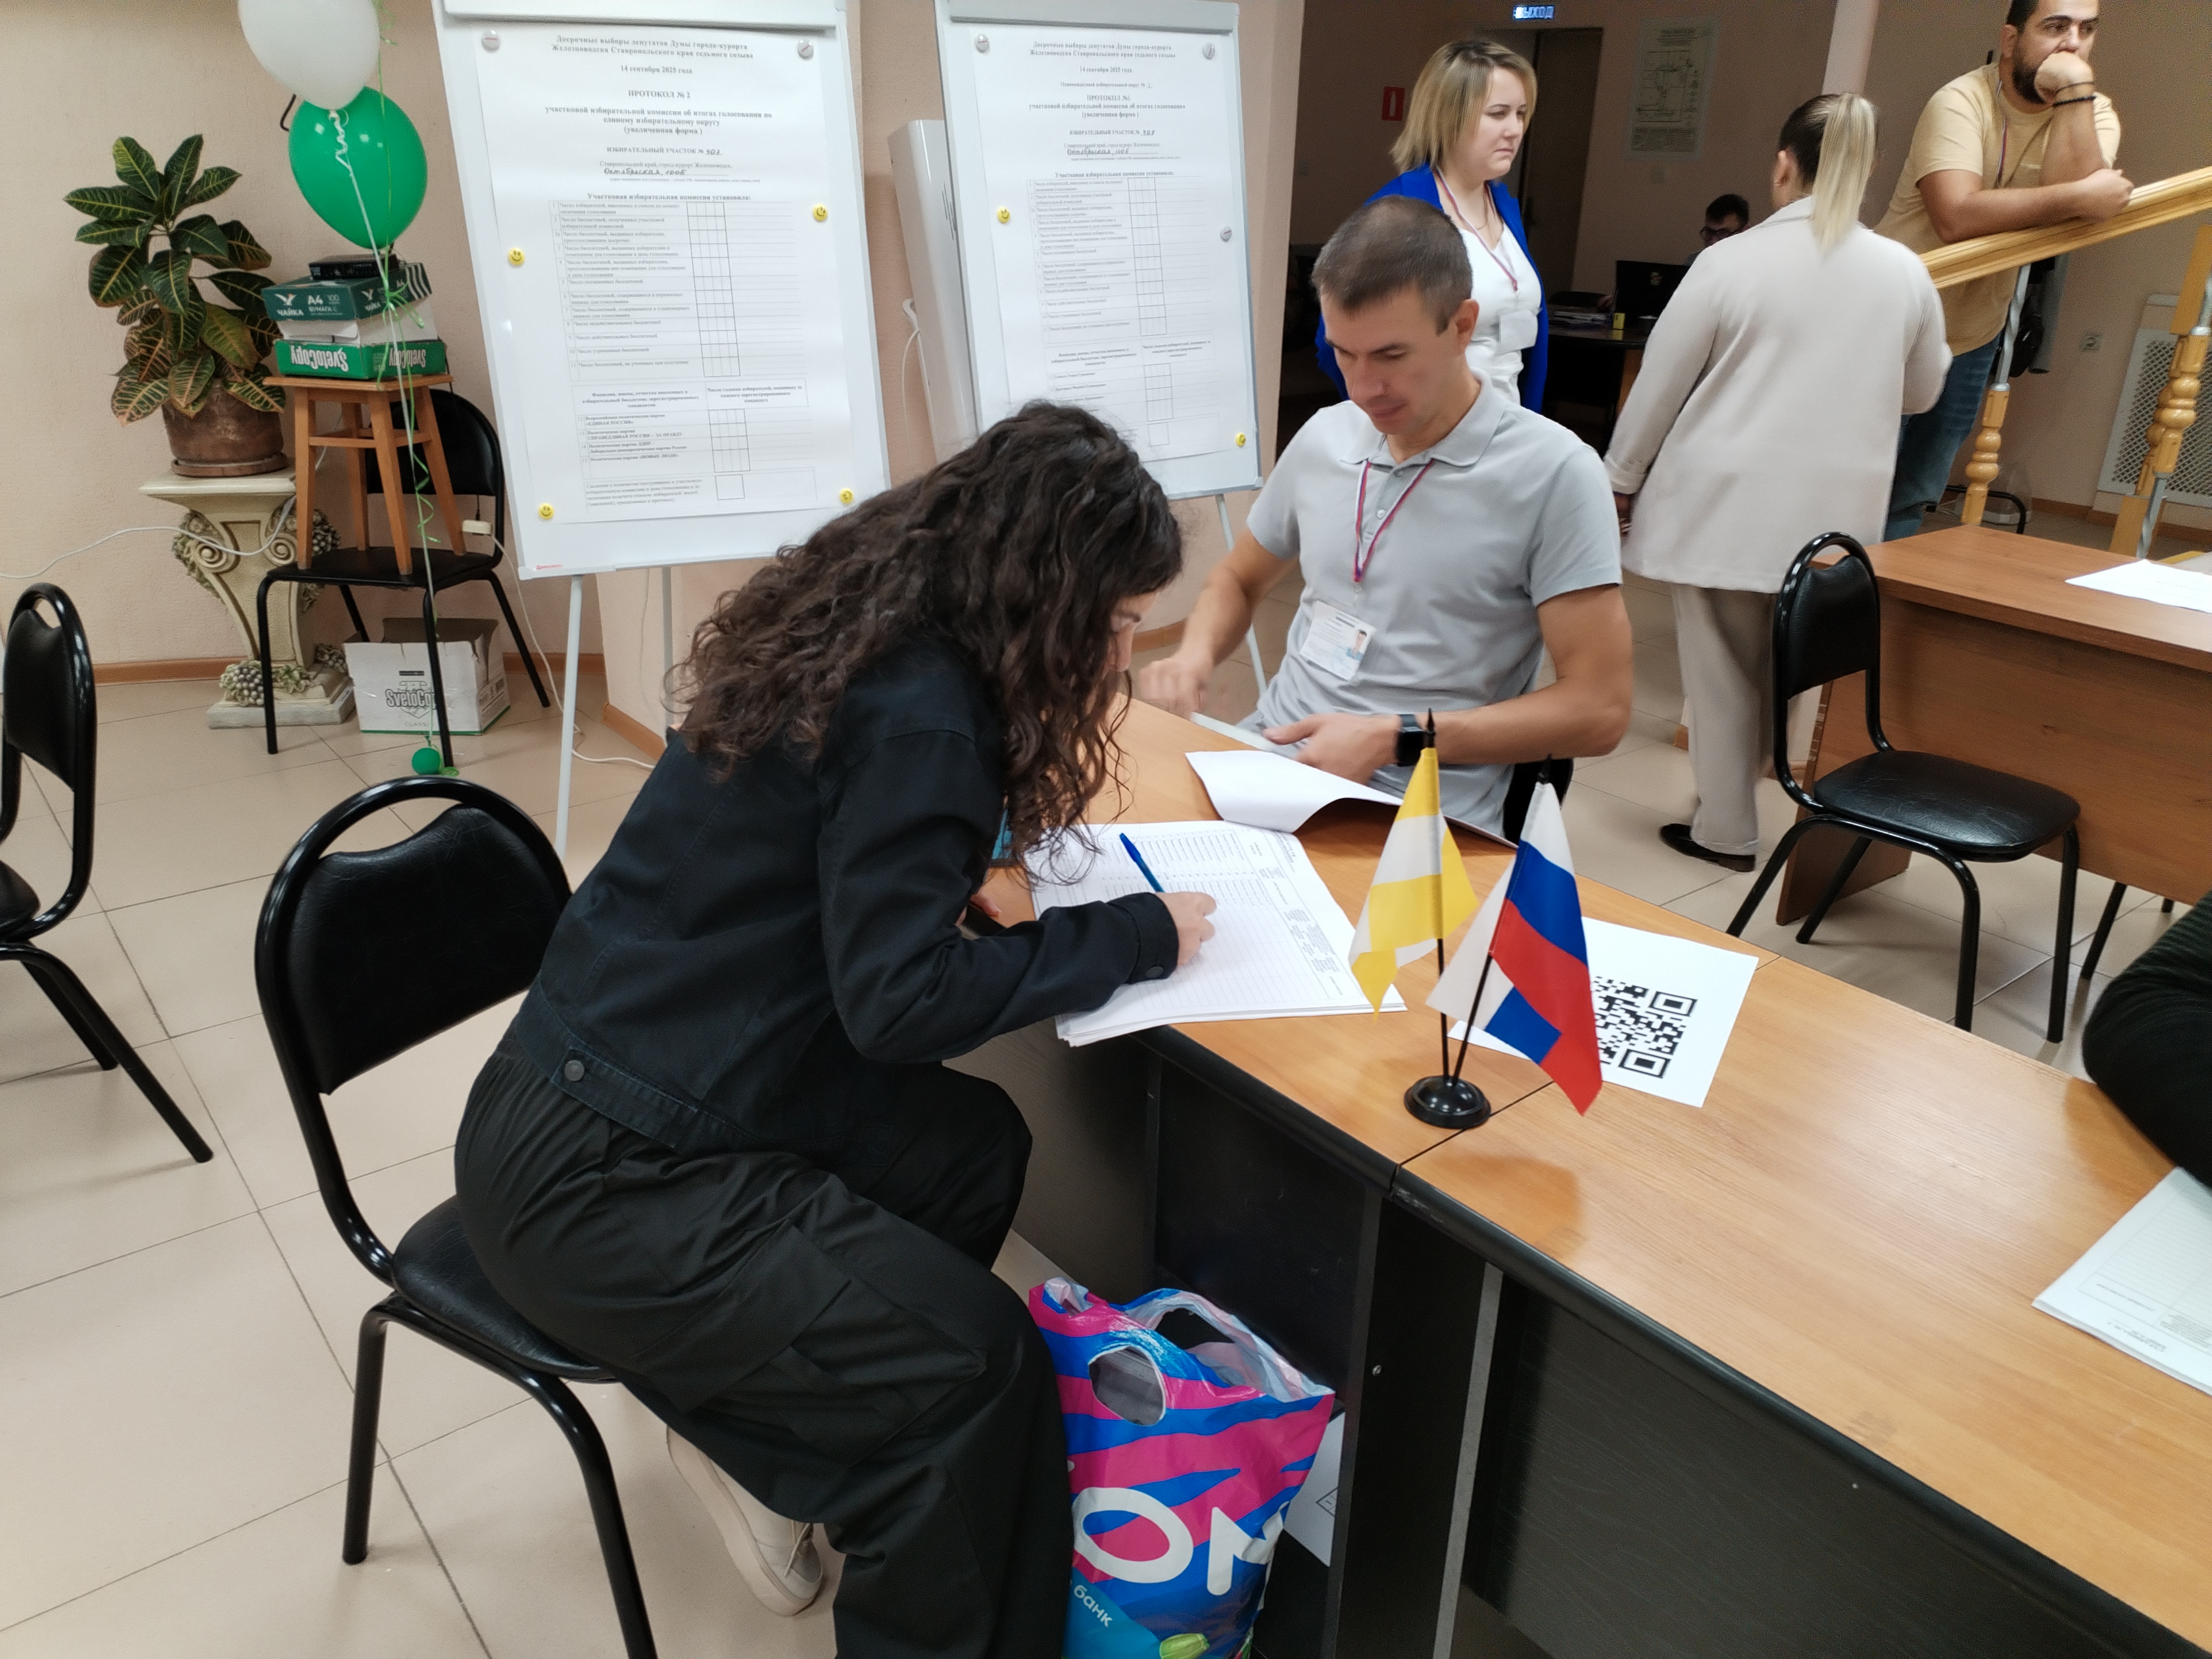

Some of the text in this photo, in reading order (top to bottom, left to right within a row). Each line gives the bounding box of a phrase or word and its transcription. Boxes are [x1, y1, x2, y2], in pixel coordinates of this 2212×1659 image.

[611, 47, 674, 55] Ставропольского
[630, 66, 661, 74] сентября
[589, 107, 645, 115] избирательной
[308, 295, 323, 305] A4
[290, 345, 349, 372] SvetoCopy
[385, 688, 436, 709] SvetoCo
[1073, 1584, 1113, 1628] банк
